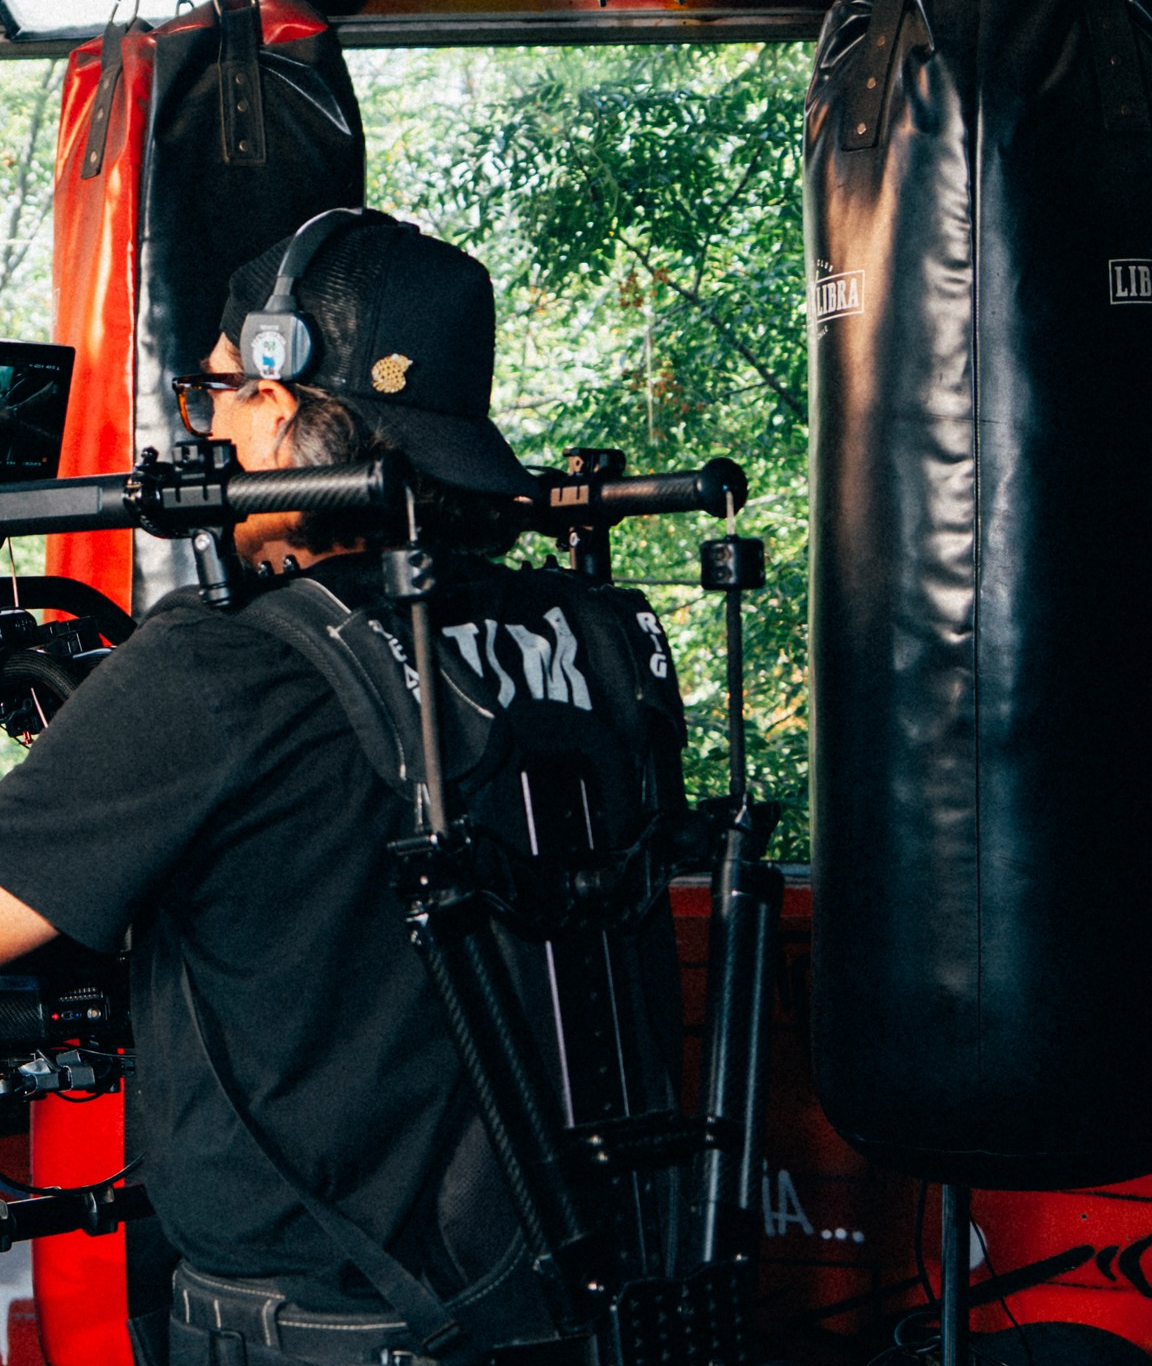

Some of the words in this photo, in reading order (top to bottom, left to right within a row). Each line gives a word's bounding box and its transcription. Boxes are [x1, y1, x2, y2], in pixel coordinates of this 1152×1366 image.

[816, 277, 859, 317] LIBRA
[1114, 265, 1152, 297] LIB
[635, 611, 668, 679] RIG
